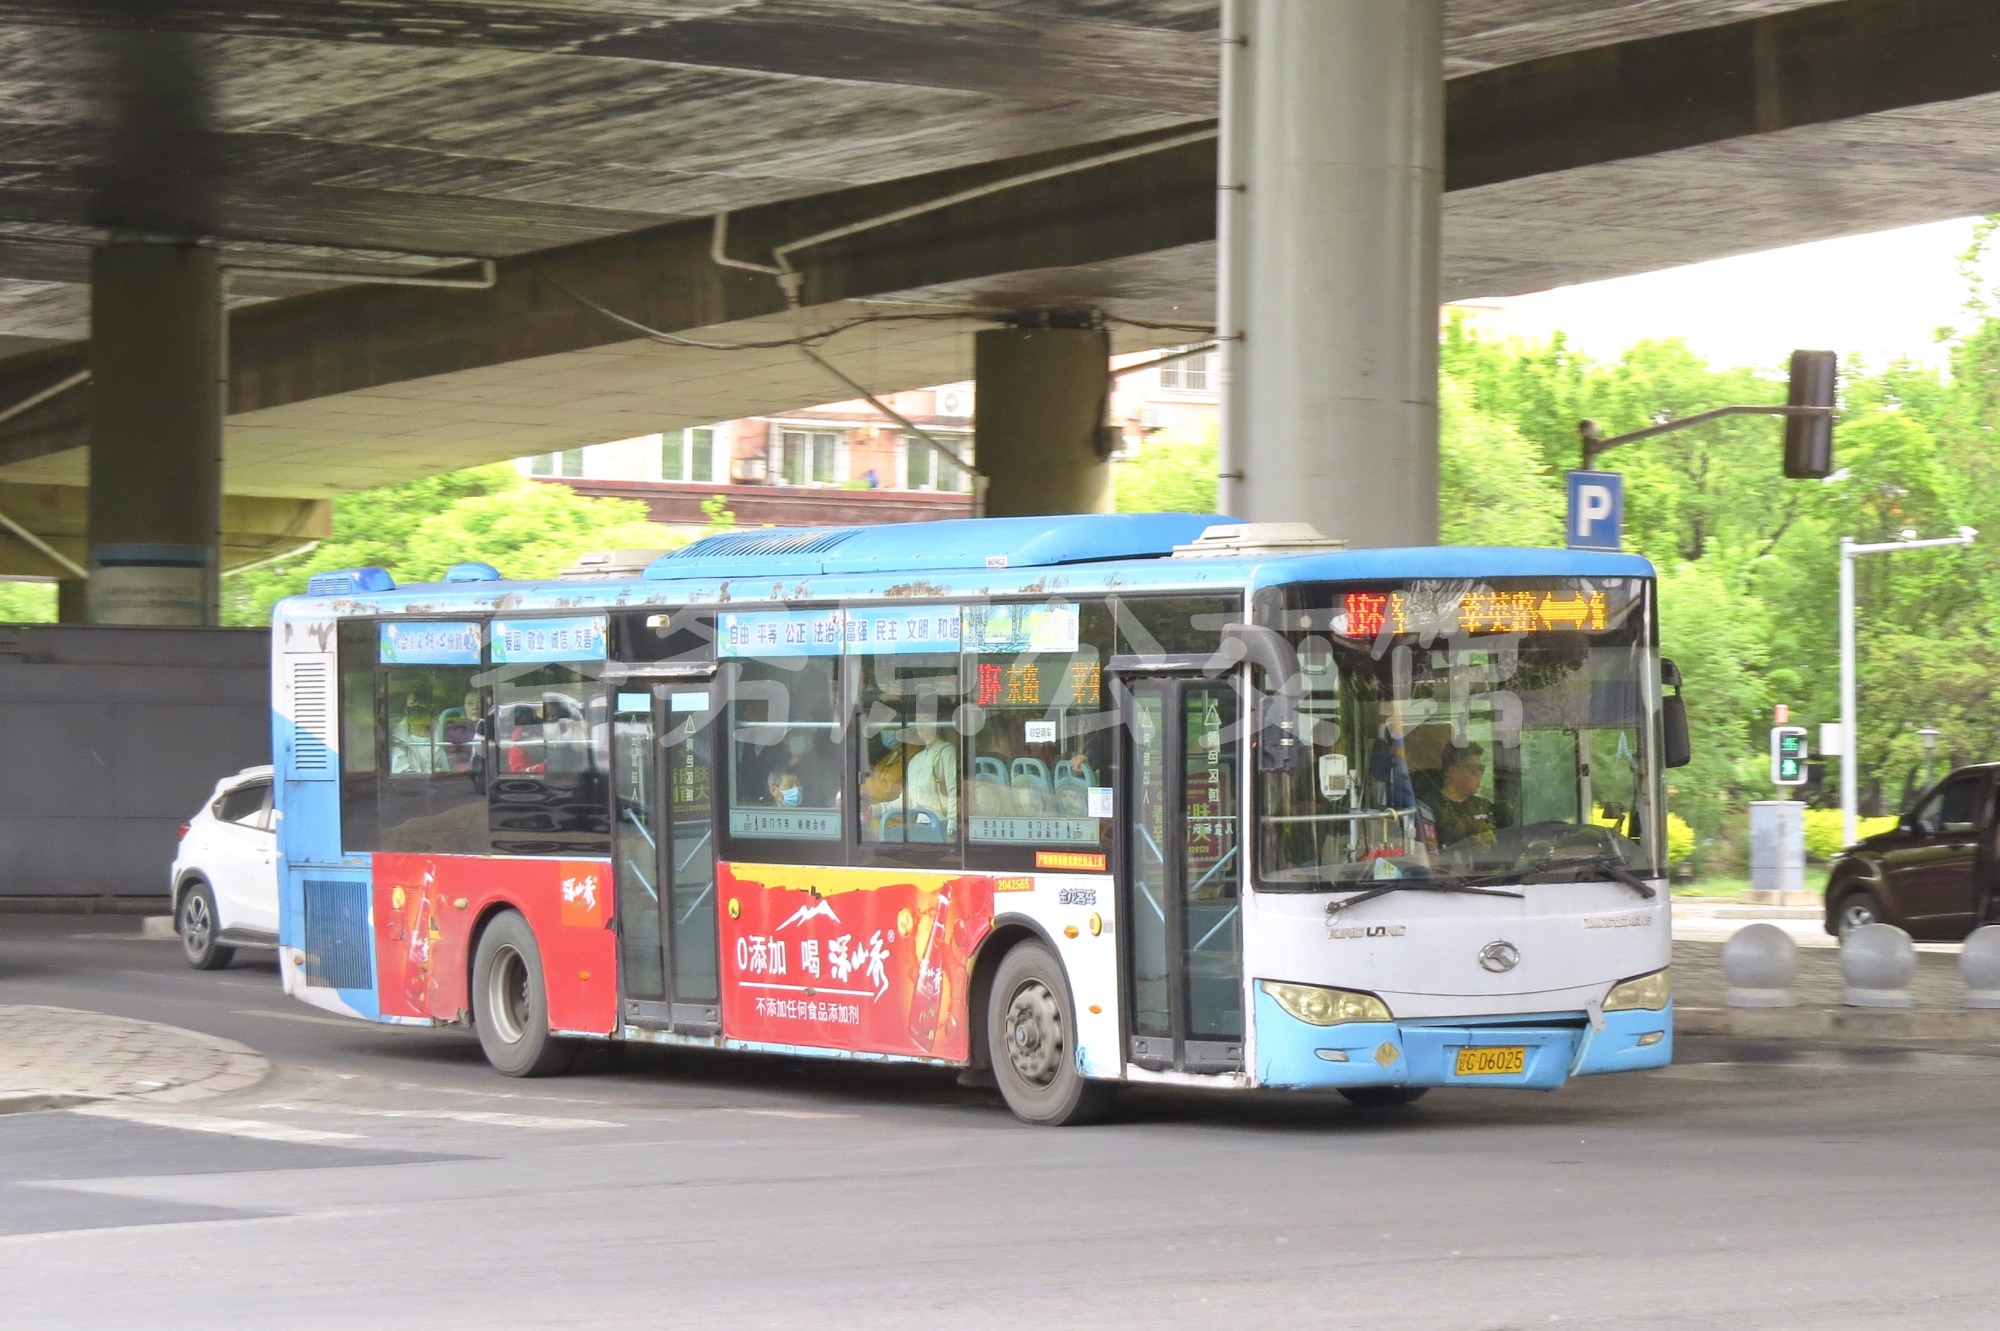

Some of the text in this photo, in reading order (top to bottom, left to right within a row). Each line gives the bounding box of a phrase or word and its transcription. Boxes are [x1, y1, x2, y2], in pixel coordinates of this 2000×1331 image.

[1578, 485, 1612, 537] P
[504, 628, 593, 651] 爱国 敬业 诚信 友善
[729, 621, 835, 646] 自由 平等 公正 法治
[846, 616, 960, 644] 富强 民主 文明 和谐
[762, 817, 790, 829] 后门下车
[997, 878, 1030, 891] 2042565
[1058, 888, 1097, 905] 金龙客车
[1328, 925, 1406, 939] KING LONG
[737, 934, 787, 975] 0添加
[801, 938, 821, 979] 喝
[755, 997, 860, 1025] 不添加任何食品添加剂
